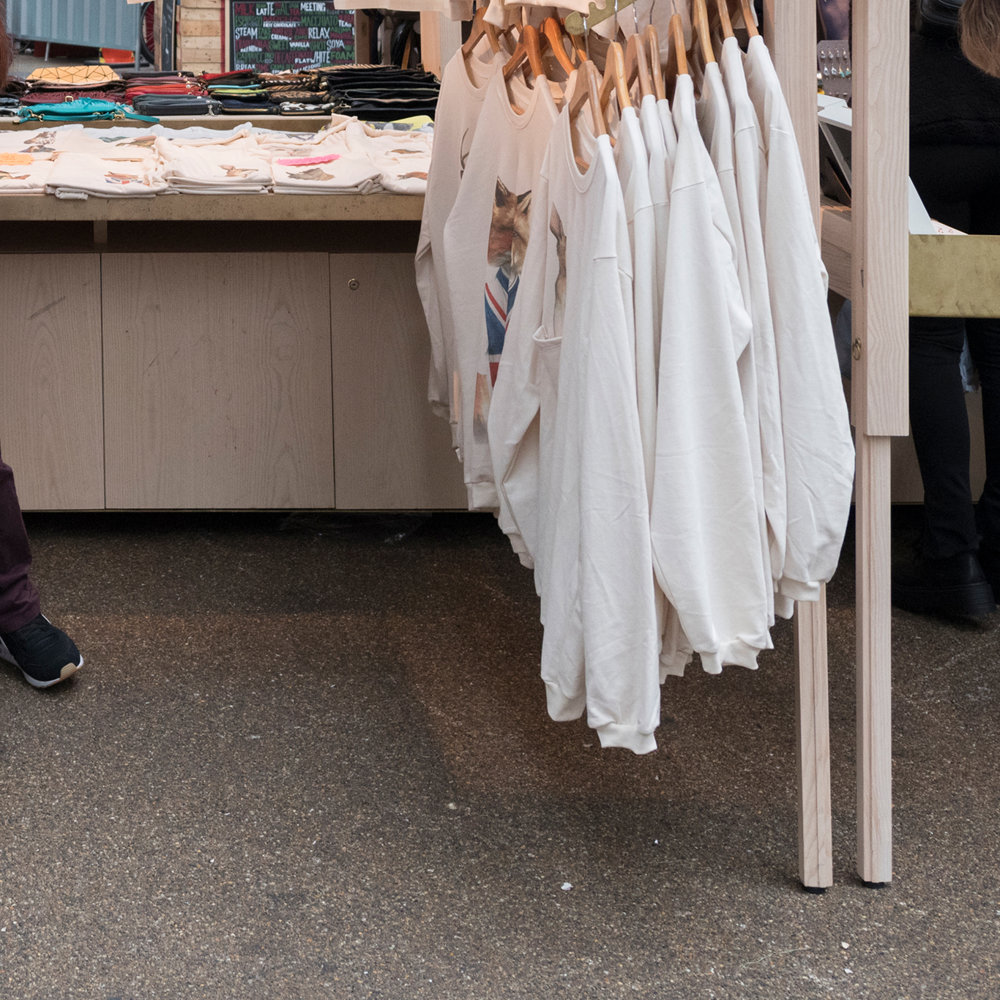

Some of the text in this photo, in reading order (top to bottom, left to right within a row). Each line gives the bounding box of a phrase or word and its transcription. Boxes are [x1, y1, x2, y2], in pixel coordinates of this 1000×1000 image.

[256, 2, 275, 16] LATTE
[300, 2, 326, 12] MEETING
[235, 27, 258, 40] STEAM
[308, 27, 330, 39] RELAX
[327, 39, 345, 51] SOYA
